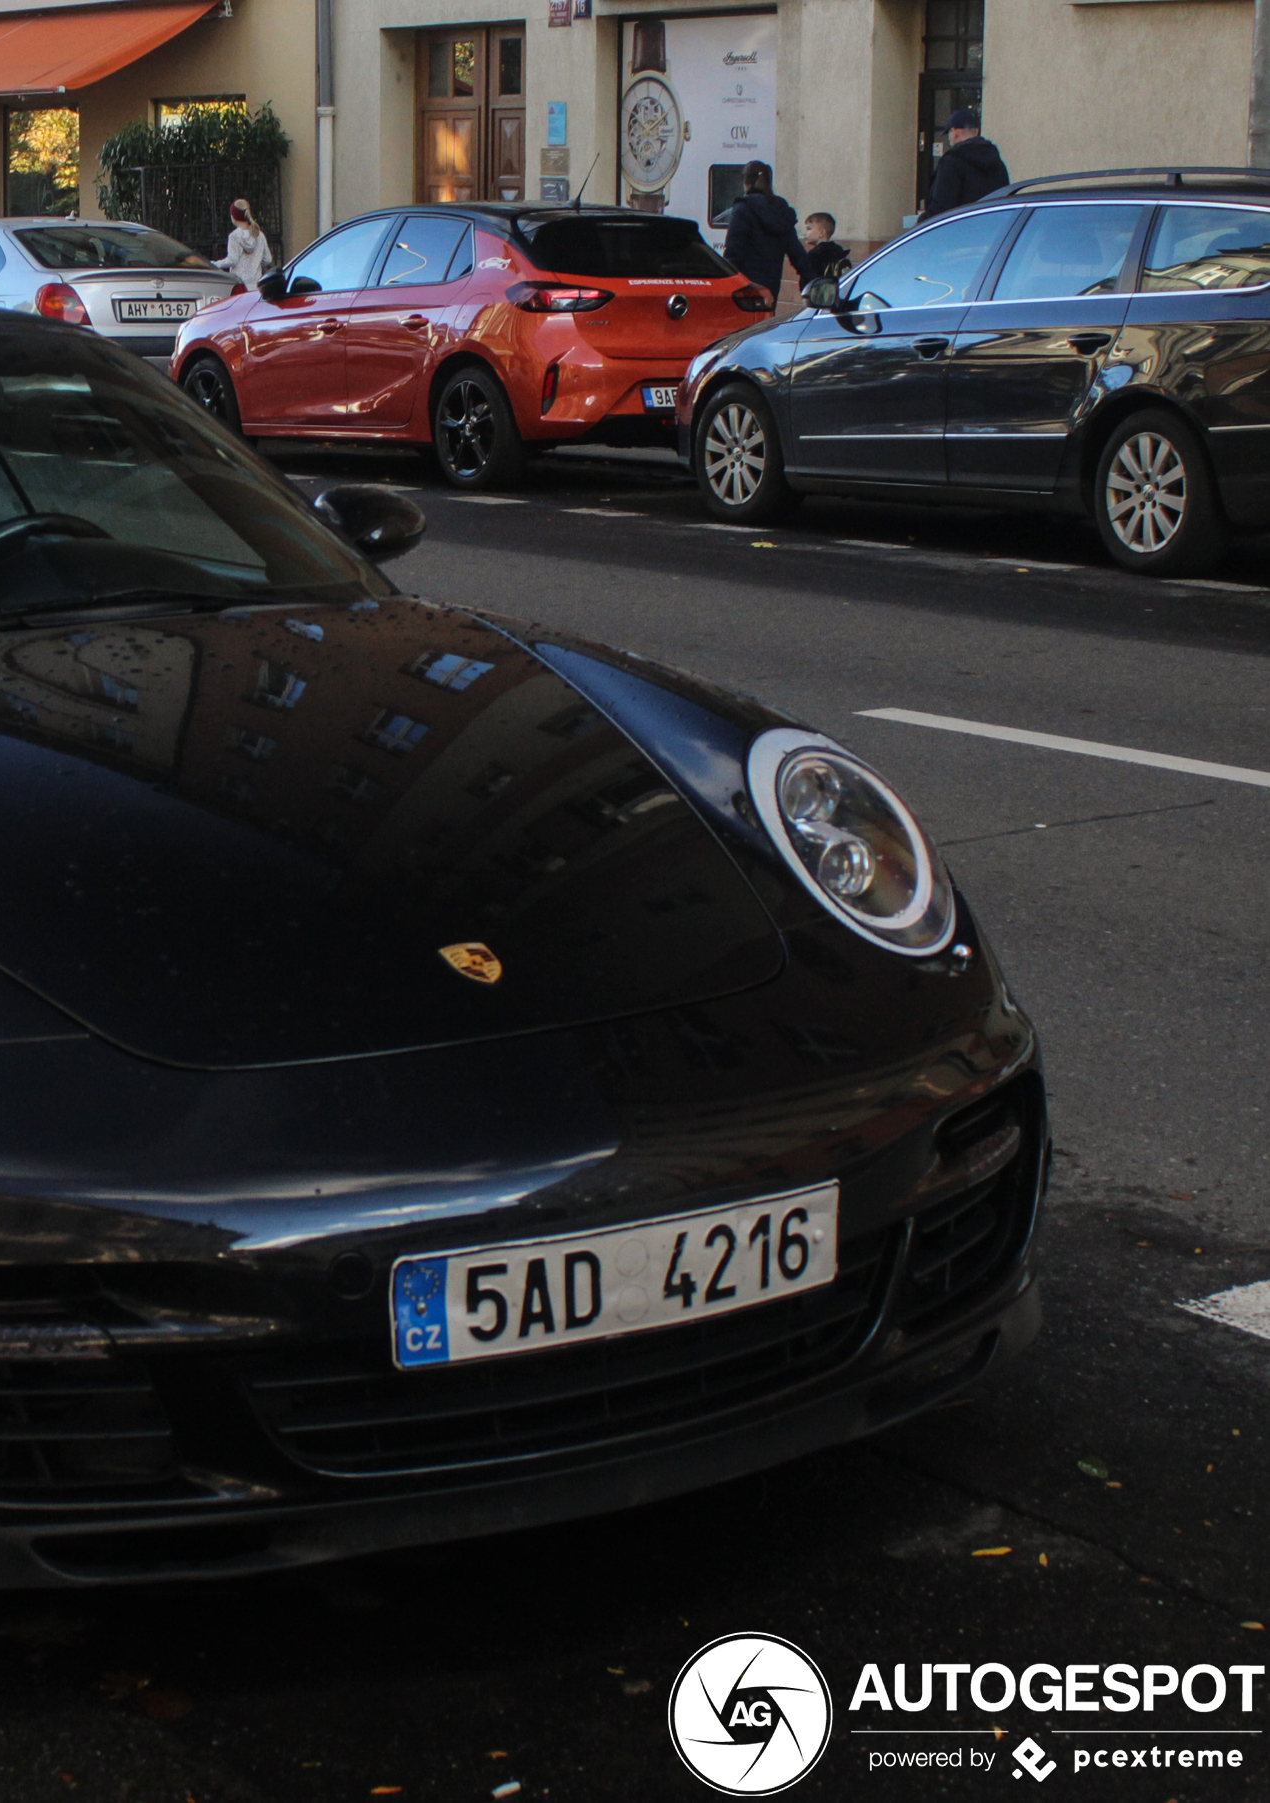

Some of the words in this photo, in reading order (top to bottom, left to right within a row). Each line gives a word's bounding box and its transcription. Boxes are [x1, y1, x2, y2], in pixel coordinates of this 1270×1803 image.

[577, 0, 586, 13] 16
[128, 303, 148, 316] AHY
[159, 303, 190, 316] 13-67
[465, 1250, 602, 1343] 5AD
[663, 1207, 810, 1309] 4216
[405, 1325, 442, 1352] CZ
